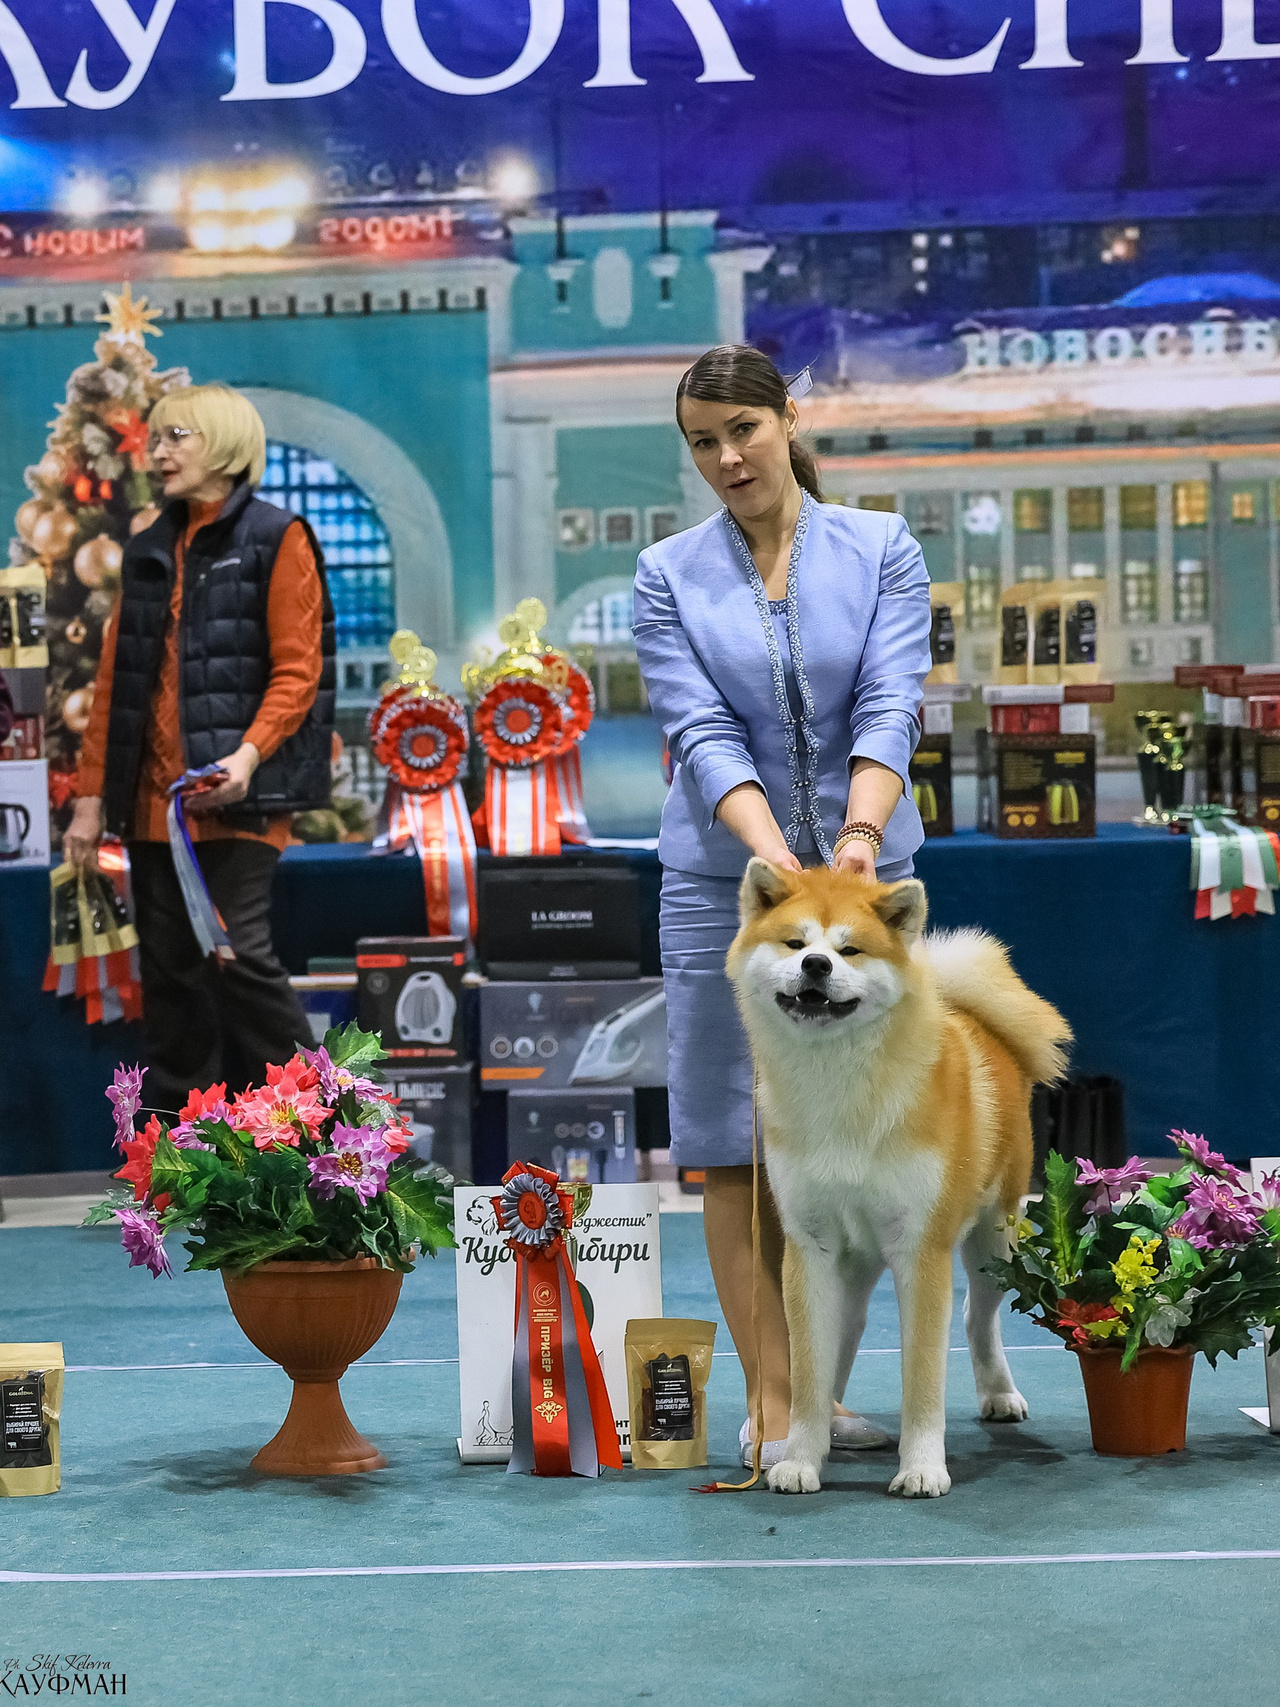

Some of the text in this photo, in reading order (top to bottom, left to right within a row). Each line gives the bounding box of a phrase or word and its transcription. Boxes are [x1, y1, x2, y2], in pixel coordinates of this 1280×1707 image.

[462, 1236, 650, 1275] Куб бири
[542, 1378, 554, 1399] BIG
